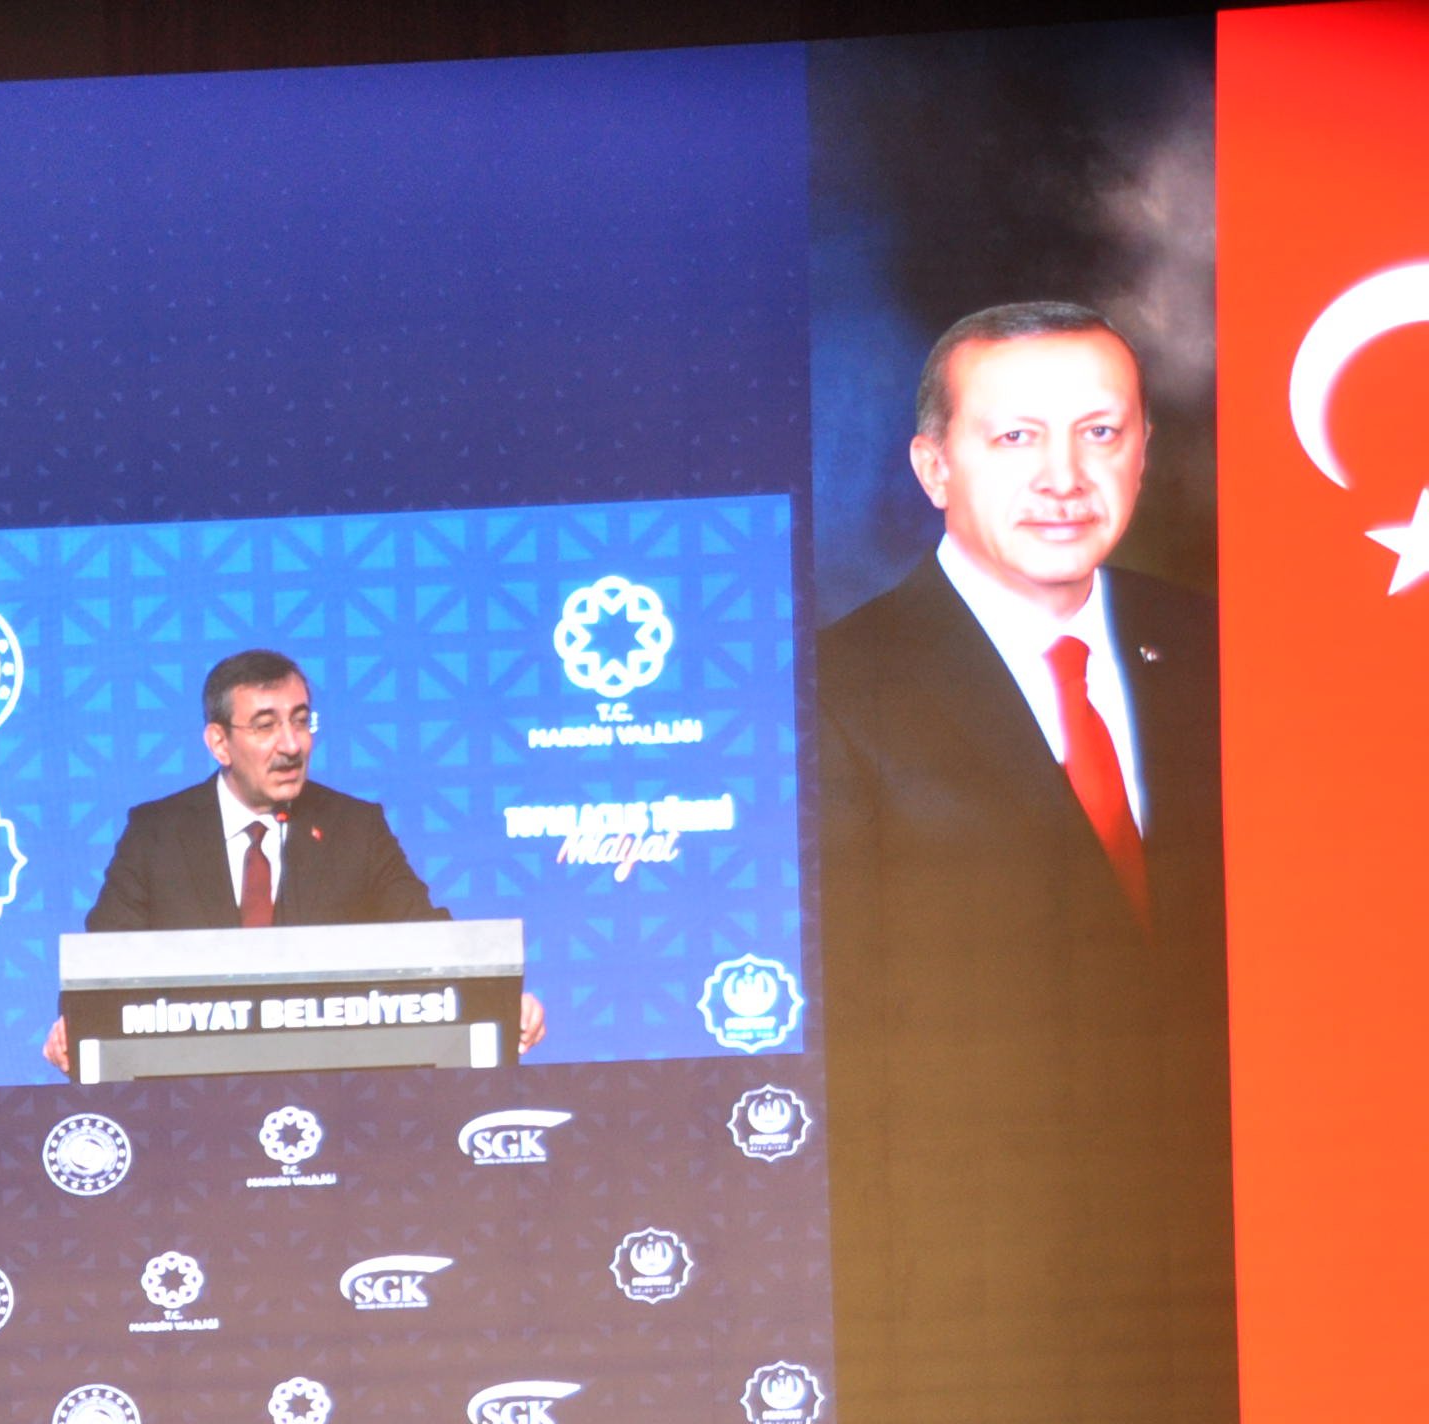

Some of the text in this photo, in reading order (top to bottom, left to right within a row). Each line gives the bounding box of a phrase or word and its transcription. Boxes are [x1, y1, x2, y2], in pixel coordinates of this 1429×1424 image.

[121, 987, 457, 1036] MİDYAT BELEDİYESİ
[473, 1129, 547, 1161] SGK
[353, 1274, 429, 1306] SGK
